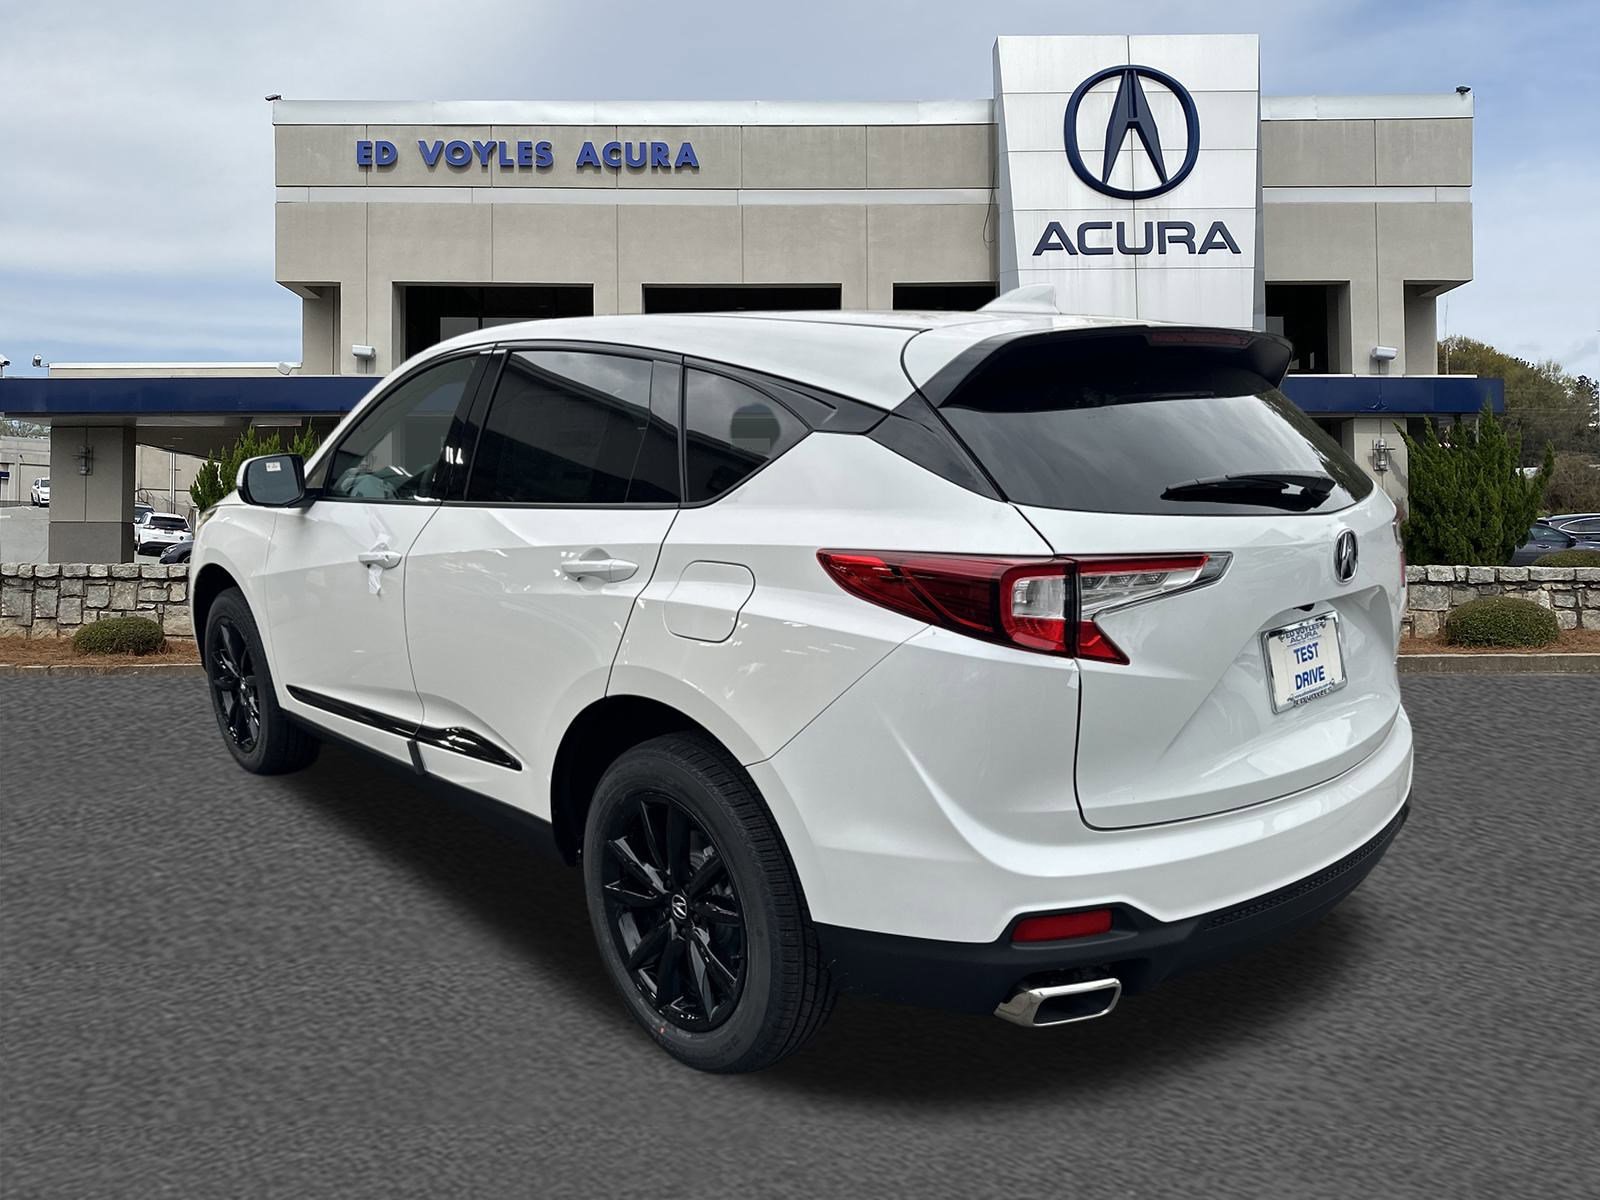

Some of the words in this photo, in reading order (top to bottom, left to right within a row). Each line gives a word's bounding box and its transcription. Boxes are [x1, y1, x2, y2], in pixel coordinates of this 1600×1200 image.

[356, 140, 398, 167] ED
[418, 140, 554, 168] VOYLES
[576, 141, 699, 168] ACURA
[1032, 221, 1242, 256] ACURA
[1290, 630, 1318, 643] ACURA
[1294, 642, 1318, 664] TEST
[1295, 665, 1325, 690] DRIVE
